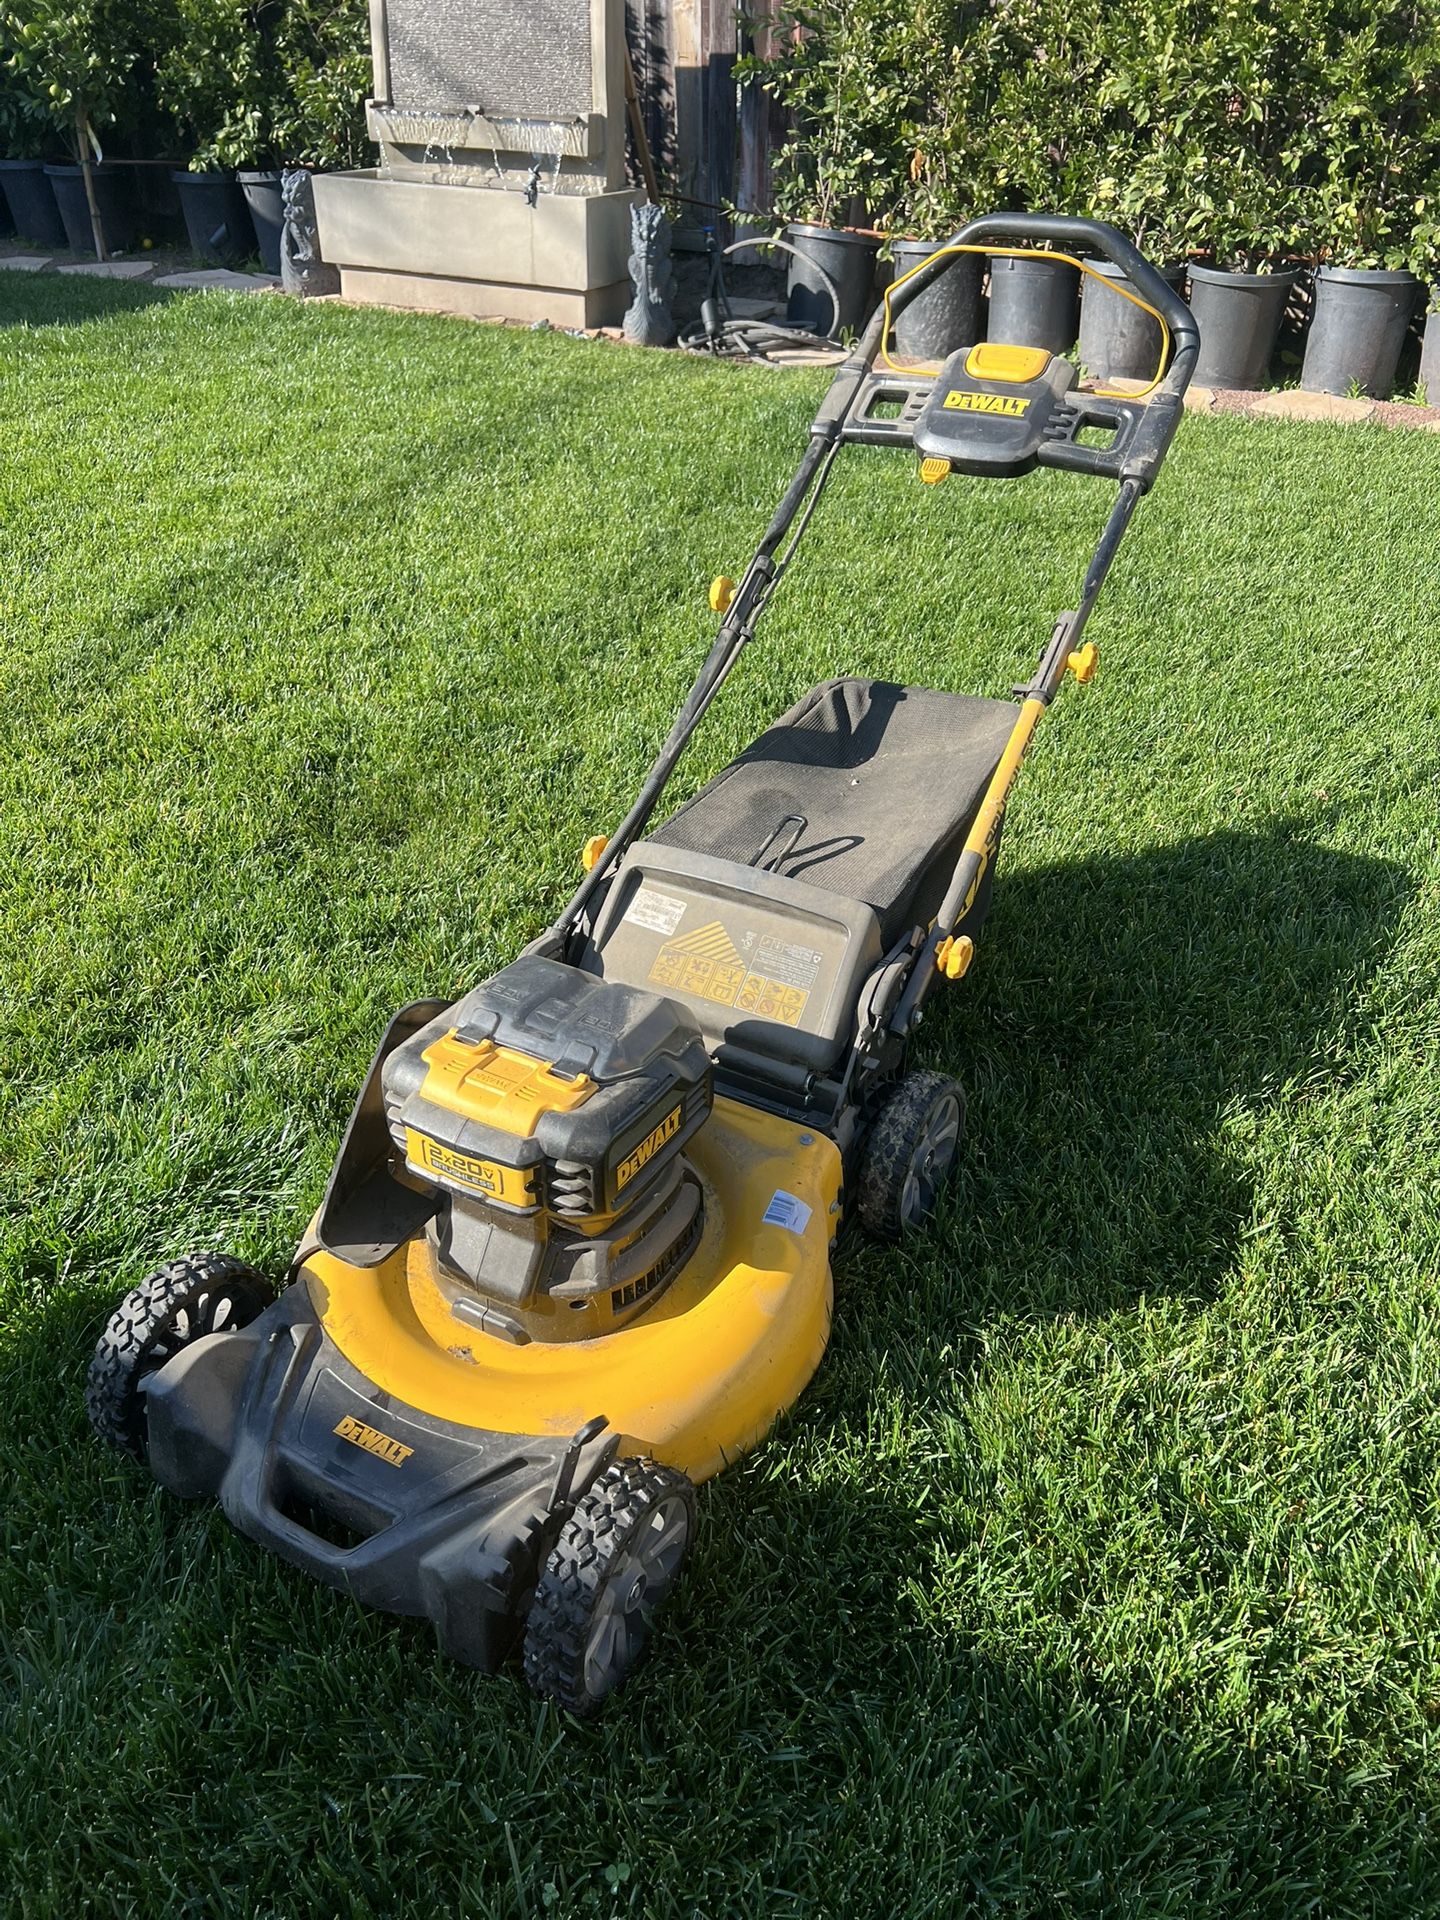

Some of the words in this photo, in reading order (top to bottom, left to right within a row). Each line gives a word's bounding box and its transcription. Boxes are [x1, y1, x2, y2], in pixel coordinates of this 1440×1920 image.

[944, 391, 1030, 416] DEWALT
[616, 1106, 682, 1190] DEWALT
[431, 1158, 495, 1191] BRUSHLESS
[333, 1416, 414, 1466] DEWALT
